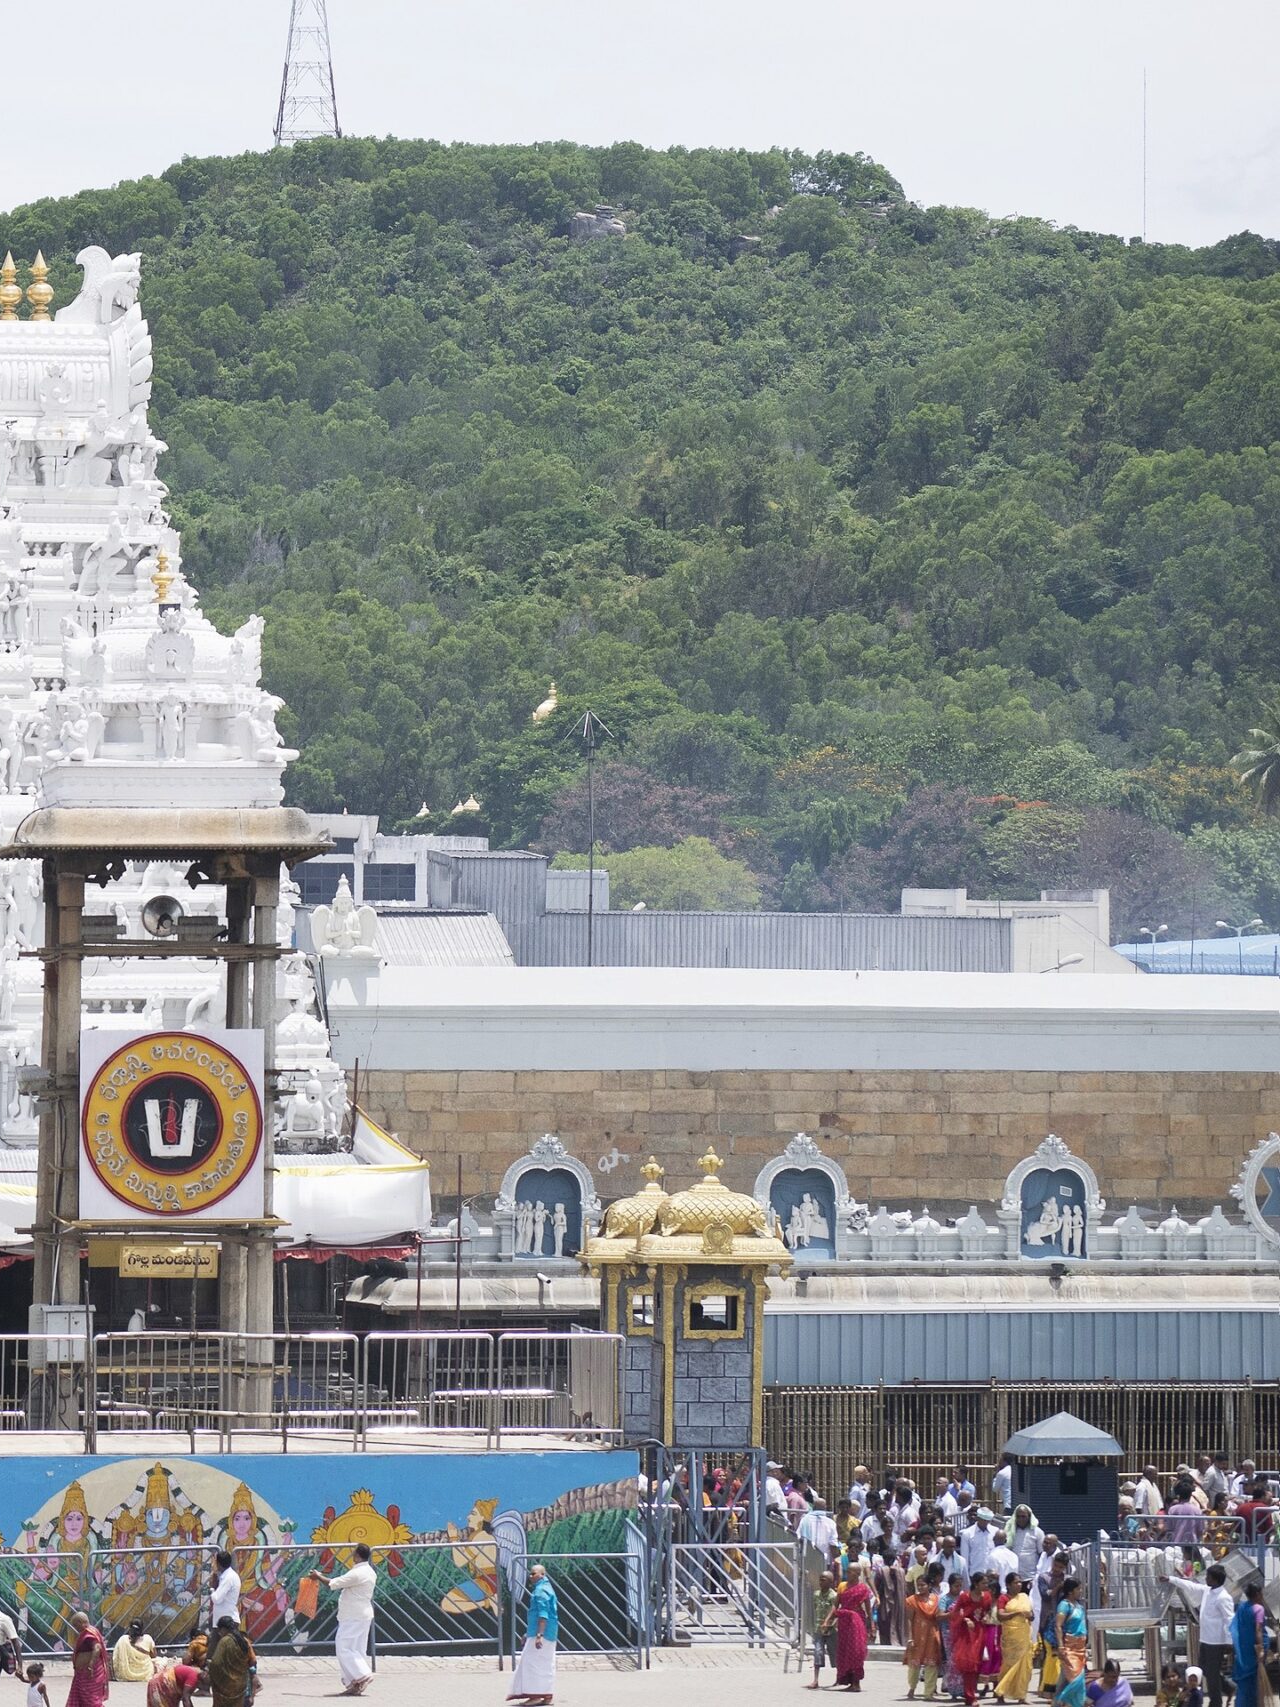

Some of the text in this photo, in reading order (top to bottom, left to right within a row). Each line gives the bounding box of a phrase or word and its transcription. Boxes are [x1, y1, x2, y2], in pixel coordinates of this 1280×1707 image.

[100, 1055, 153, 1100] ధర్మాన్ని
[183, 1111, 249, 1199] కాపాడుతుంది
[128, 1253, 211, 1268] గొల్ల మండపము
